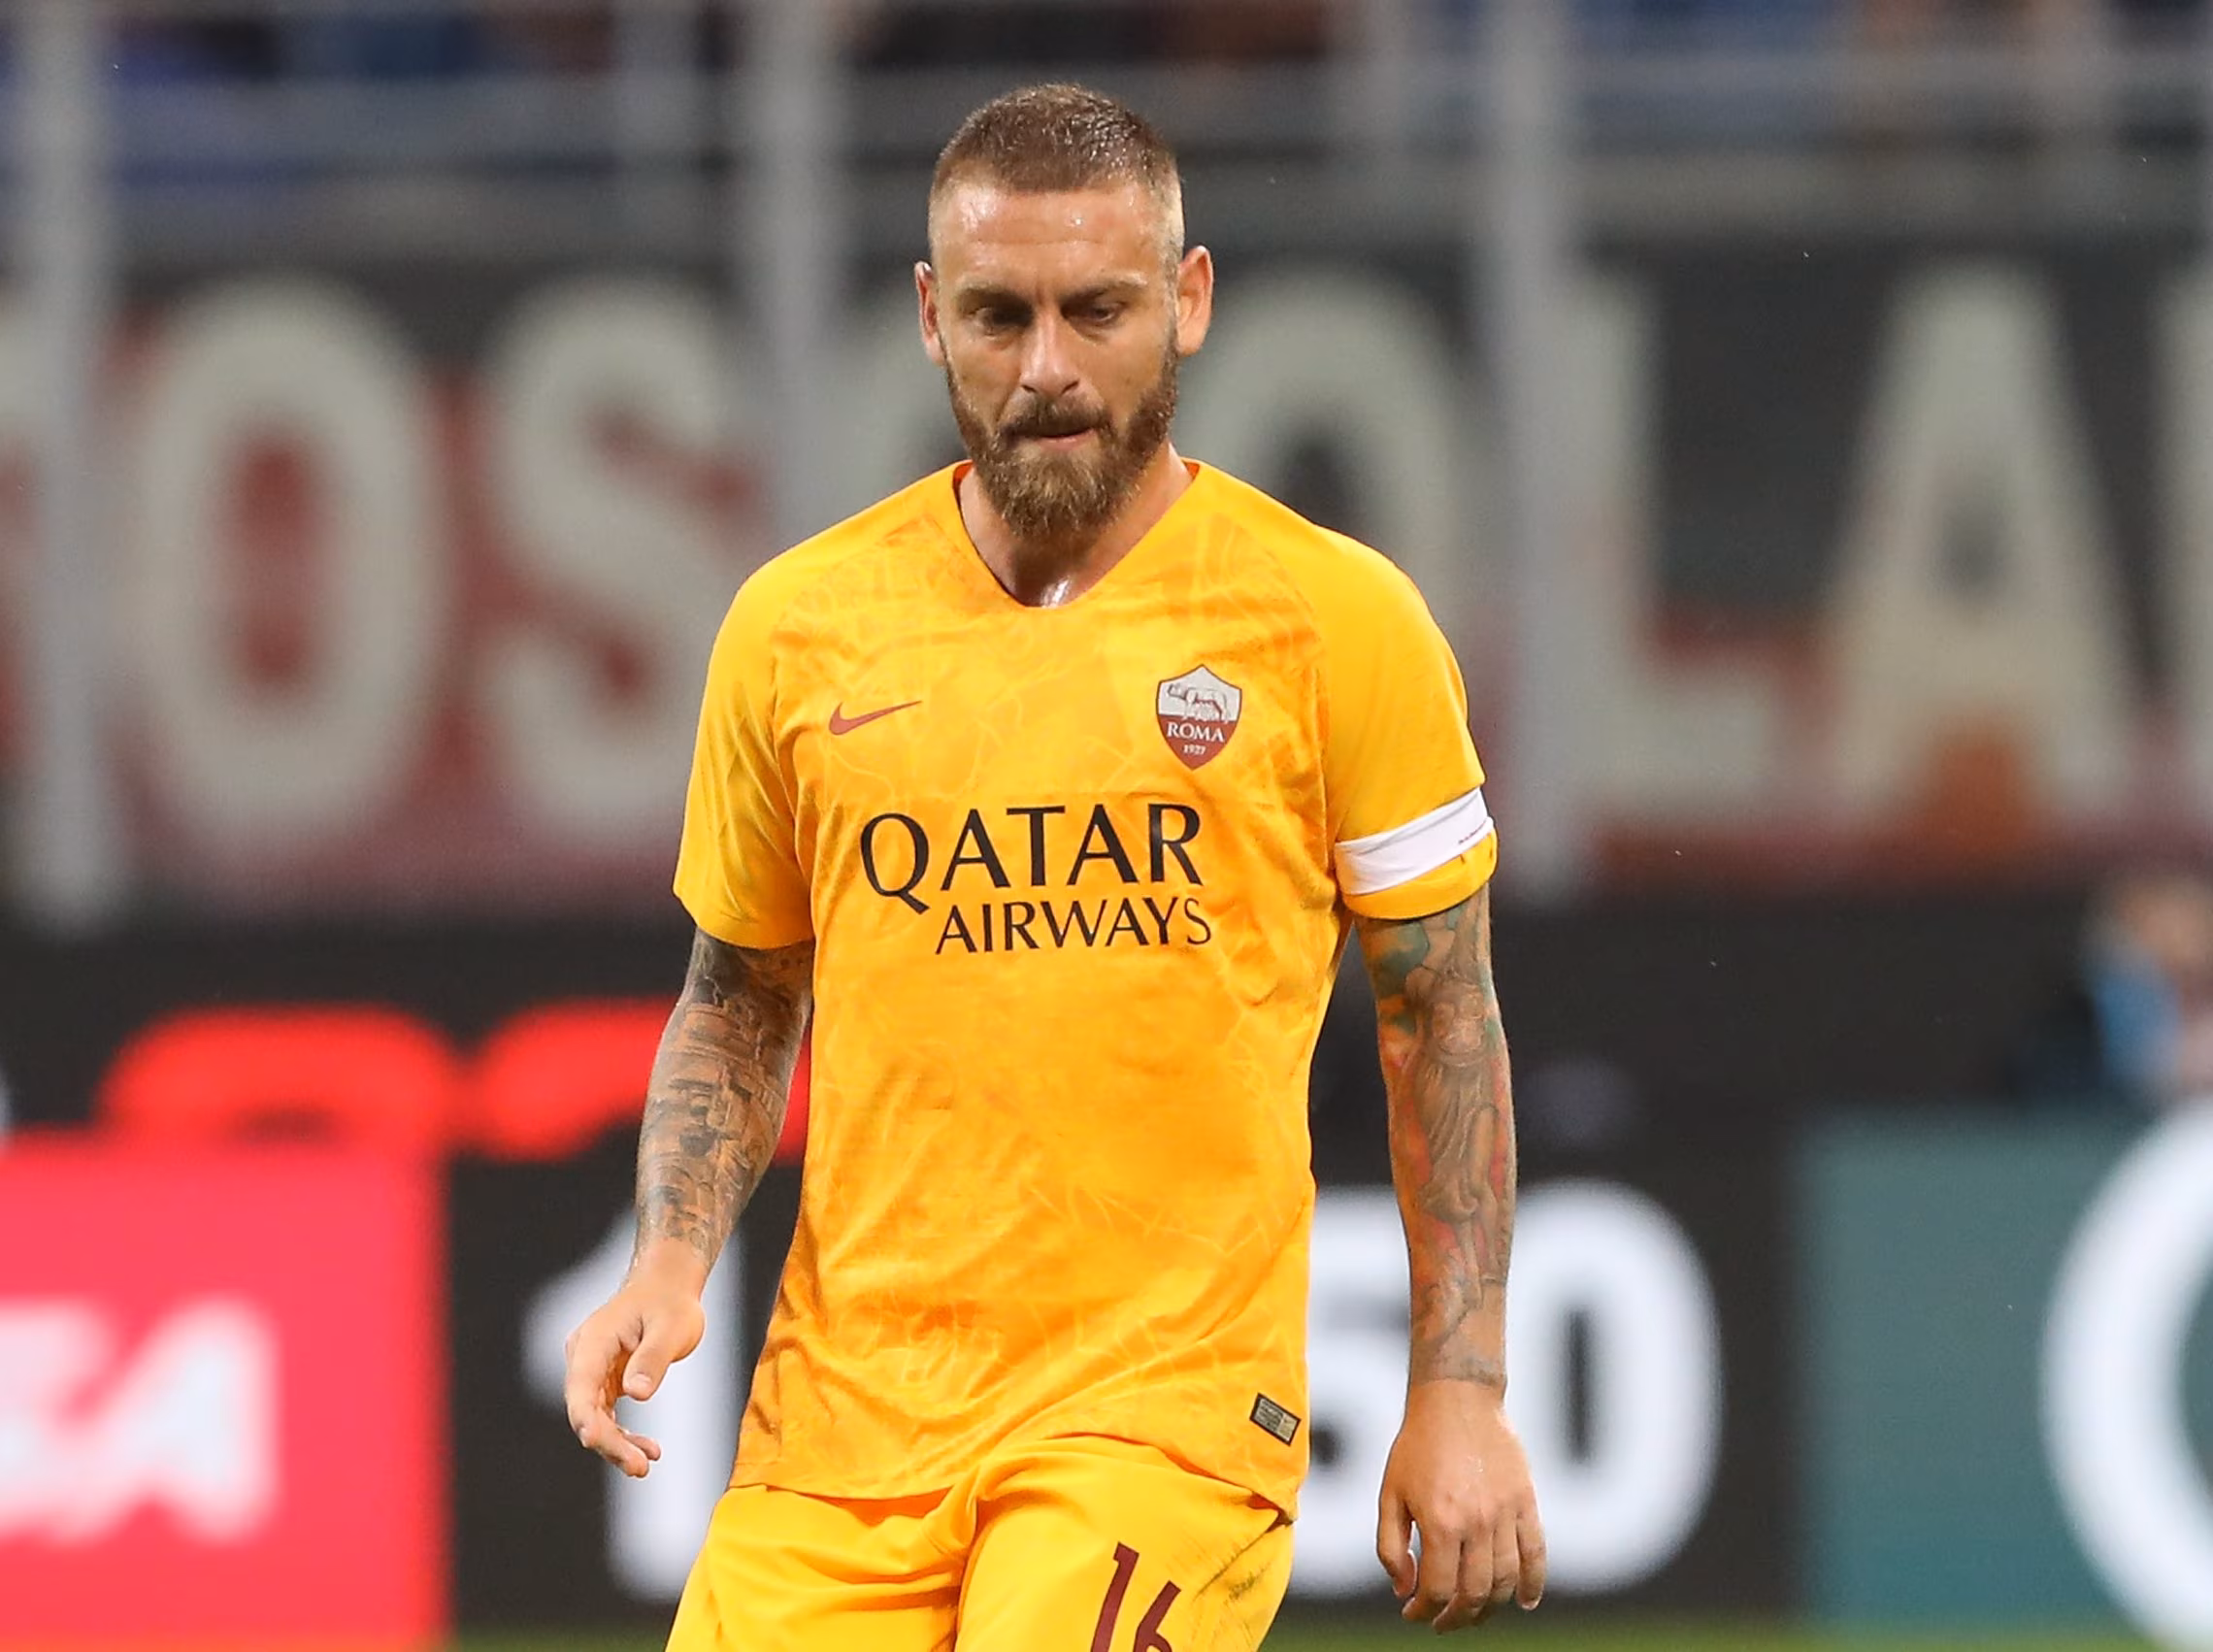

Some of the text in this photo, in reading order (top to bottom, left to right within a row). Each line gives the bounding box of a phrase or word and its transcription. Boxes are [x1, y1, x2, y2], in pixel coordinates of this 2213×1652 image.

[1167, 721, 1225, 743] ROMA
[1182, 743, 1206, 755] 1927
[860, 804, 1204, 914] QATAR
[936, 897, 1211, 955] AIRWAYS
[1090, 1541, 1182, 1652] 16
